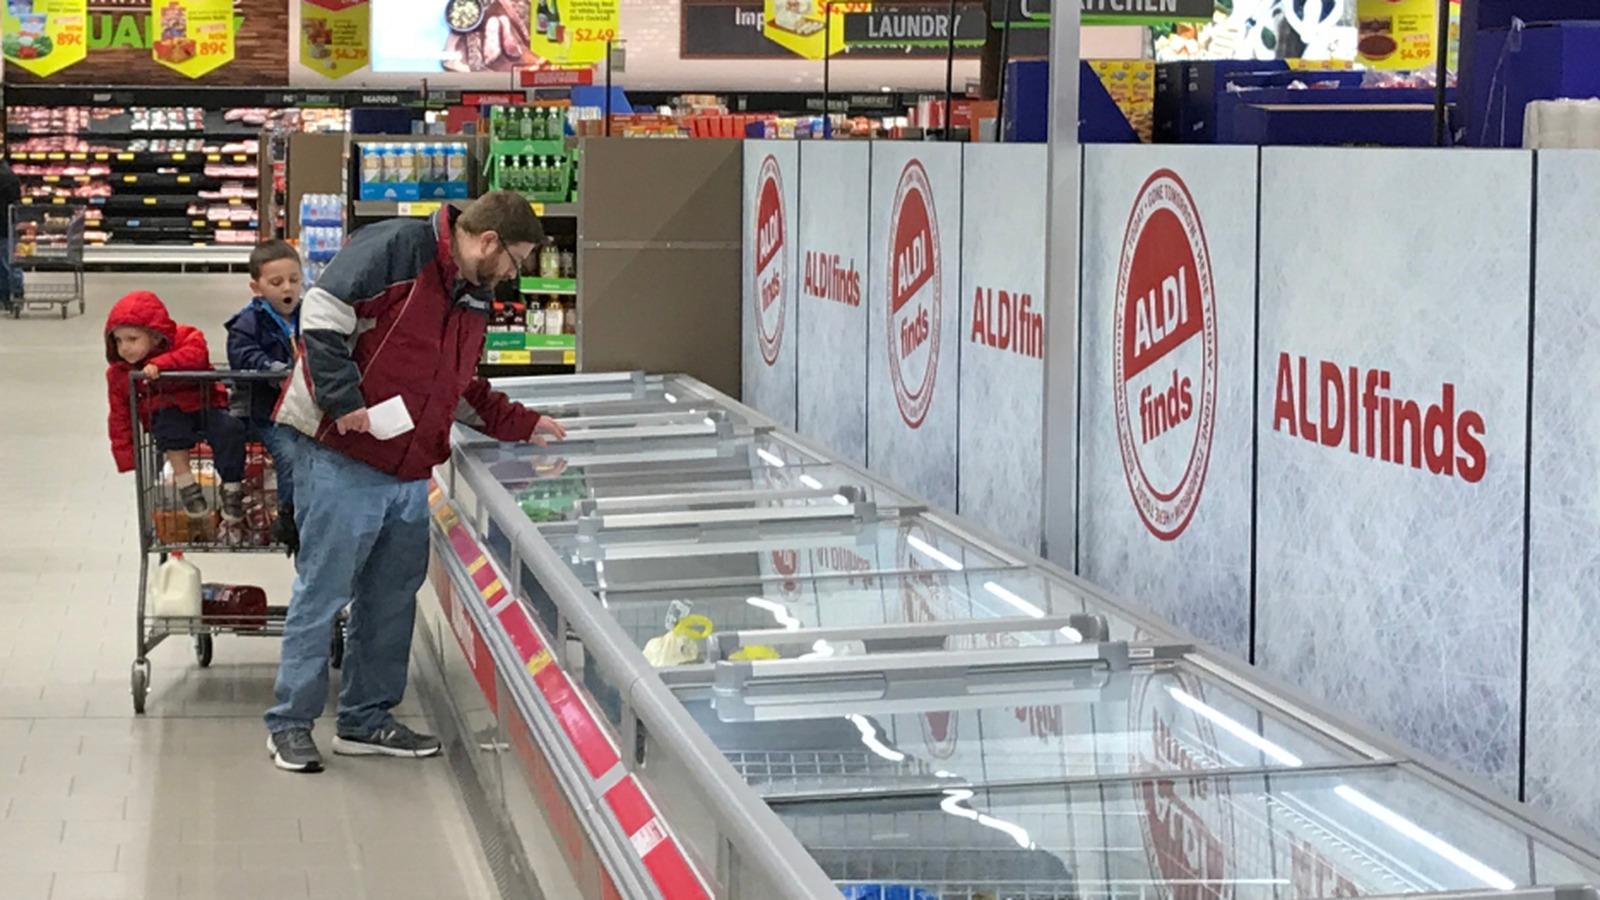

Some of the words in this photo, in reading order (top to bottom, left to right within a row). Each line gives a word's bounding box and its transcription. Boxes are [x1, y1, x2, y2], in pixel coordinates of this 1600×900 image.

[576, 27, 615, 42] $2.49
[735, 7, 765, 32] Imp
[868, 15, 961, 37] LAUNDRY
[200, 42, 227, 56] 89¢
[760, 209, 779, 264] ALDI
[898, 229, 926, 298] ALDI
[762, 266, 781, 312] finds
[804, 250, 860, 307] ALDIfinds
[901, 303, 929, 360] finds
[971, 286, 1043, 359] ALDIfin
[1134, 265, 1188, 358] ALDI
[1139, 368, 1193, 445] finds
[1273, 351, 1487, 483] ALDIfinds
